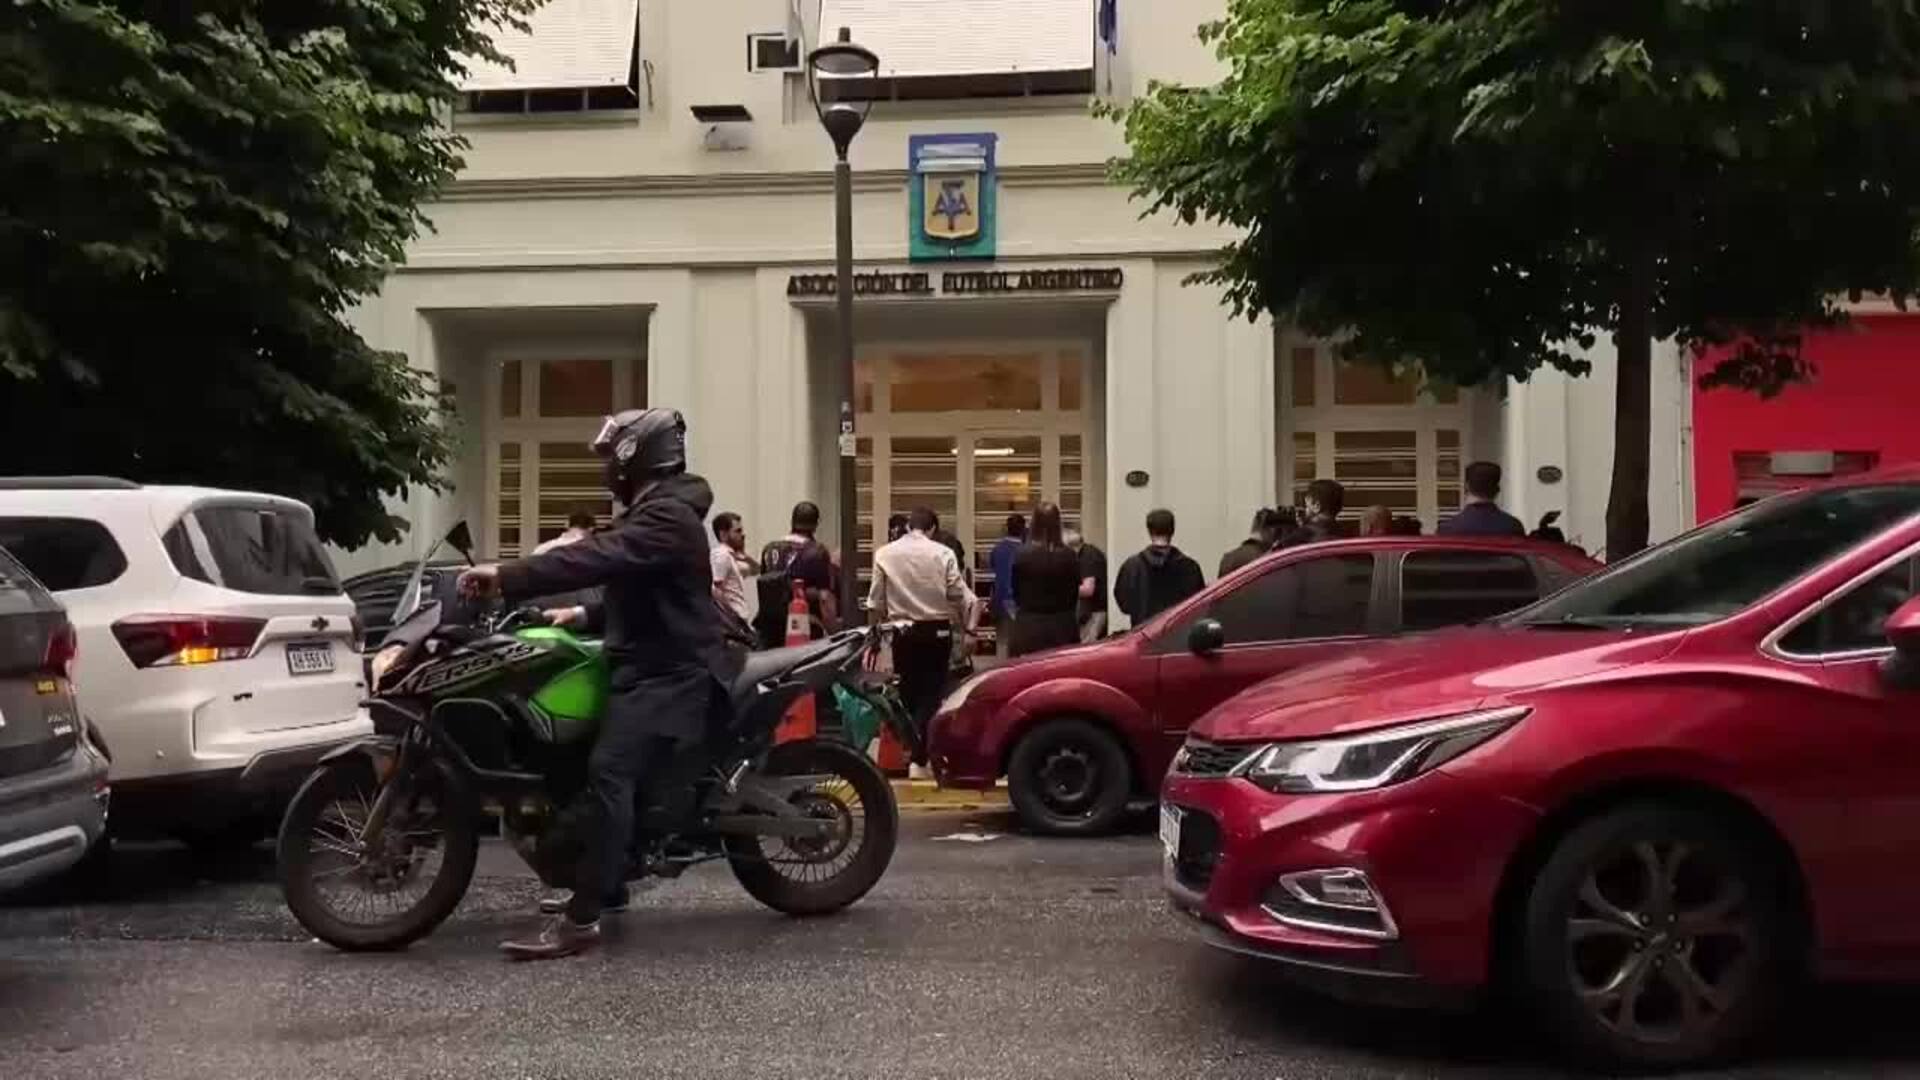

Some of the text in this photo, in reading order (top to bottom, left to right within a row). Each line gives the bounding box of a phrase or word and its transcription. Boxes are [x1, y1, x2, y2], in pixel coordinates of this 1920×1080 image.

[787, 268, 897, 295] ASOCCIÓN
[901, 272, 935, 294] DEL
[1018, 266, 1123, 290] ARGENTINO
